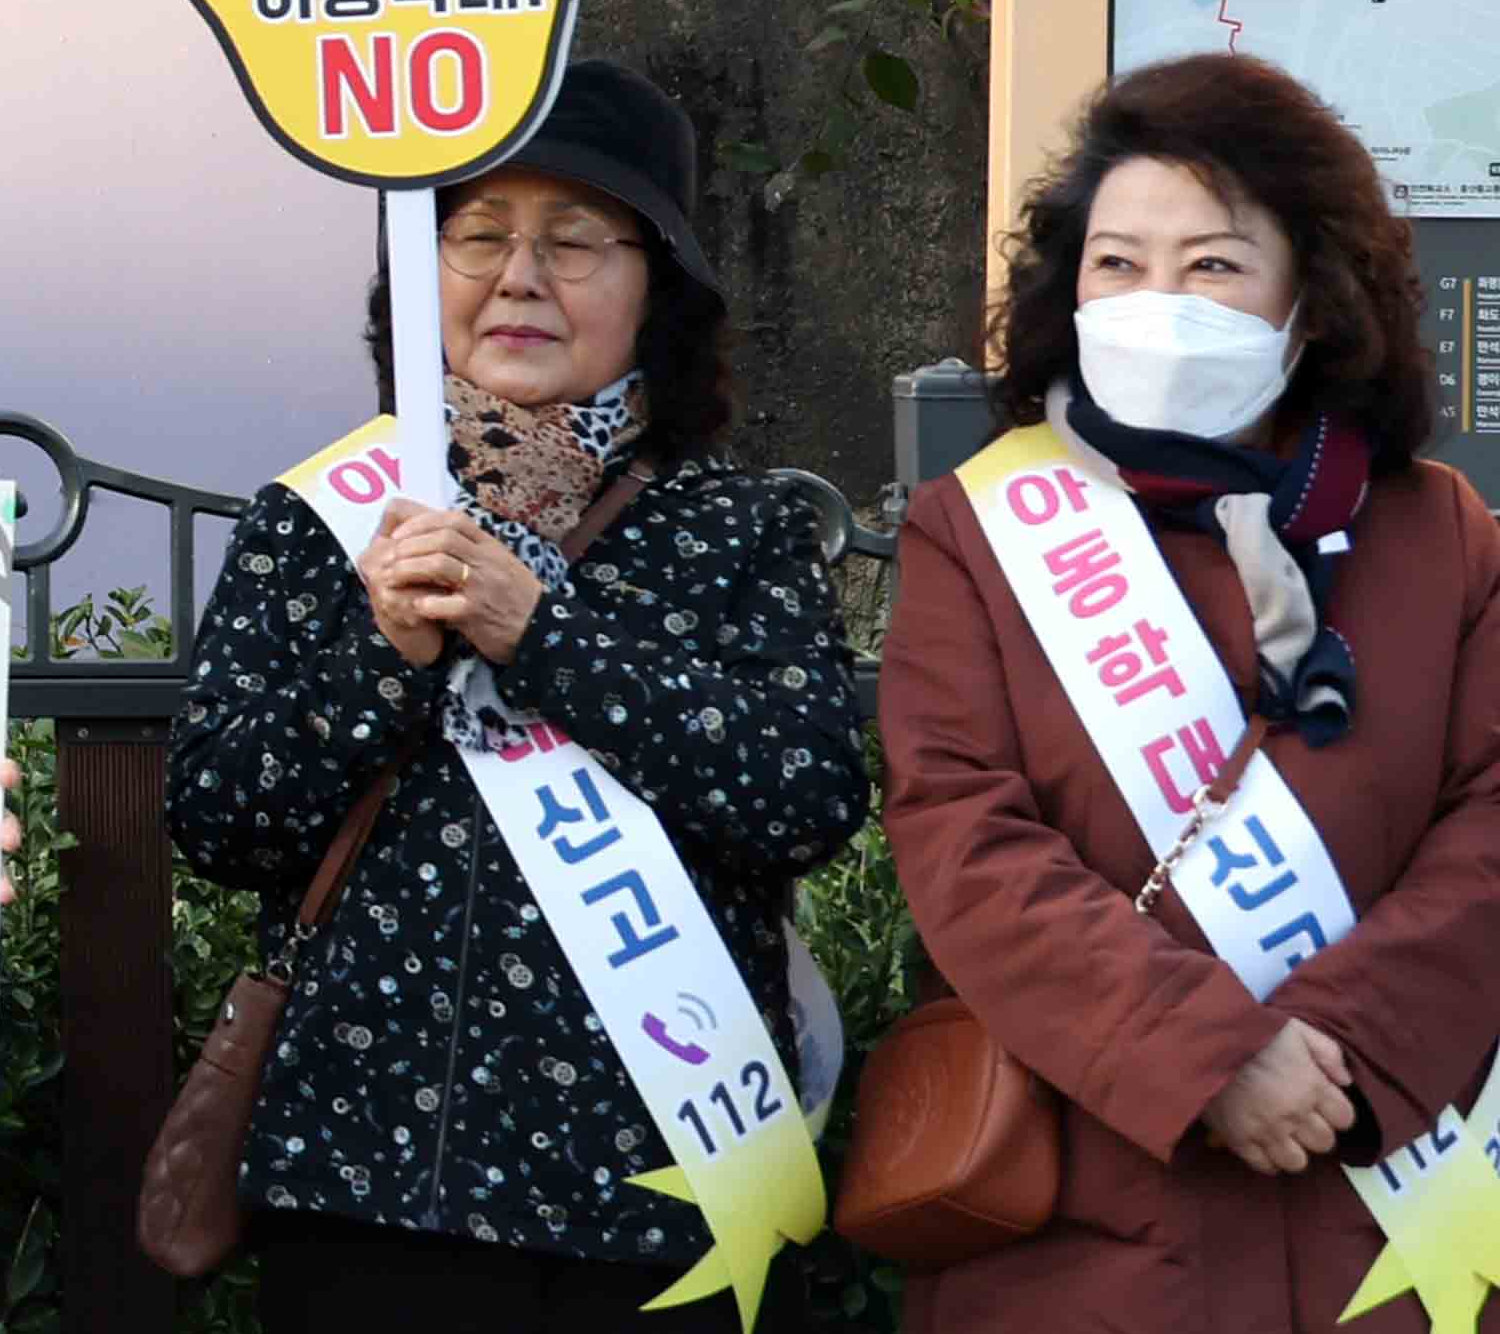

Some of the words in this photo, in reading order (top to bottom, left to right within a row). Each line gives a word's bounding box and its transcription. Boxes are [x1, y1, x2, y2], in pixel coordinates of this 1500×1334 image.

[320, 30, 484, 136] NO
[1005, 468, 1231, 815] 아동학대
[534, 766, 681, 970] 신고
[676, 1059, 783, 1157] 112
